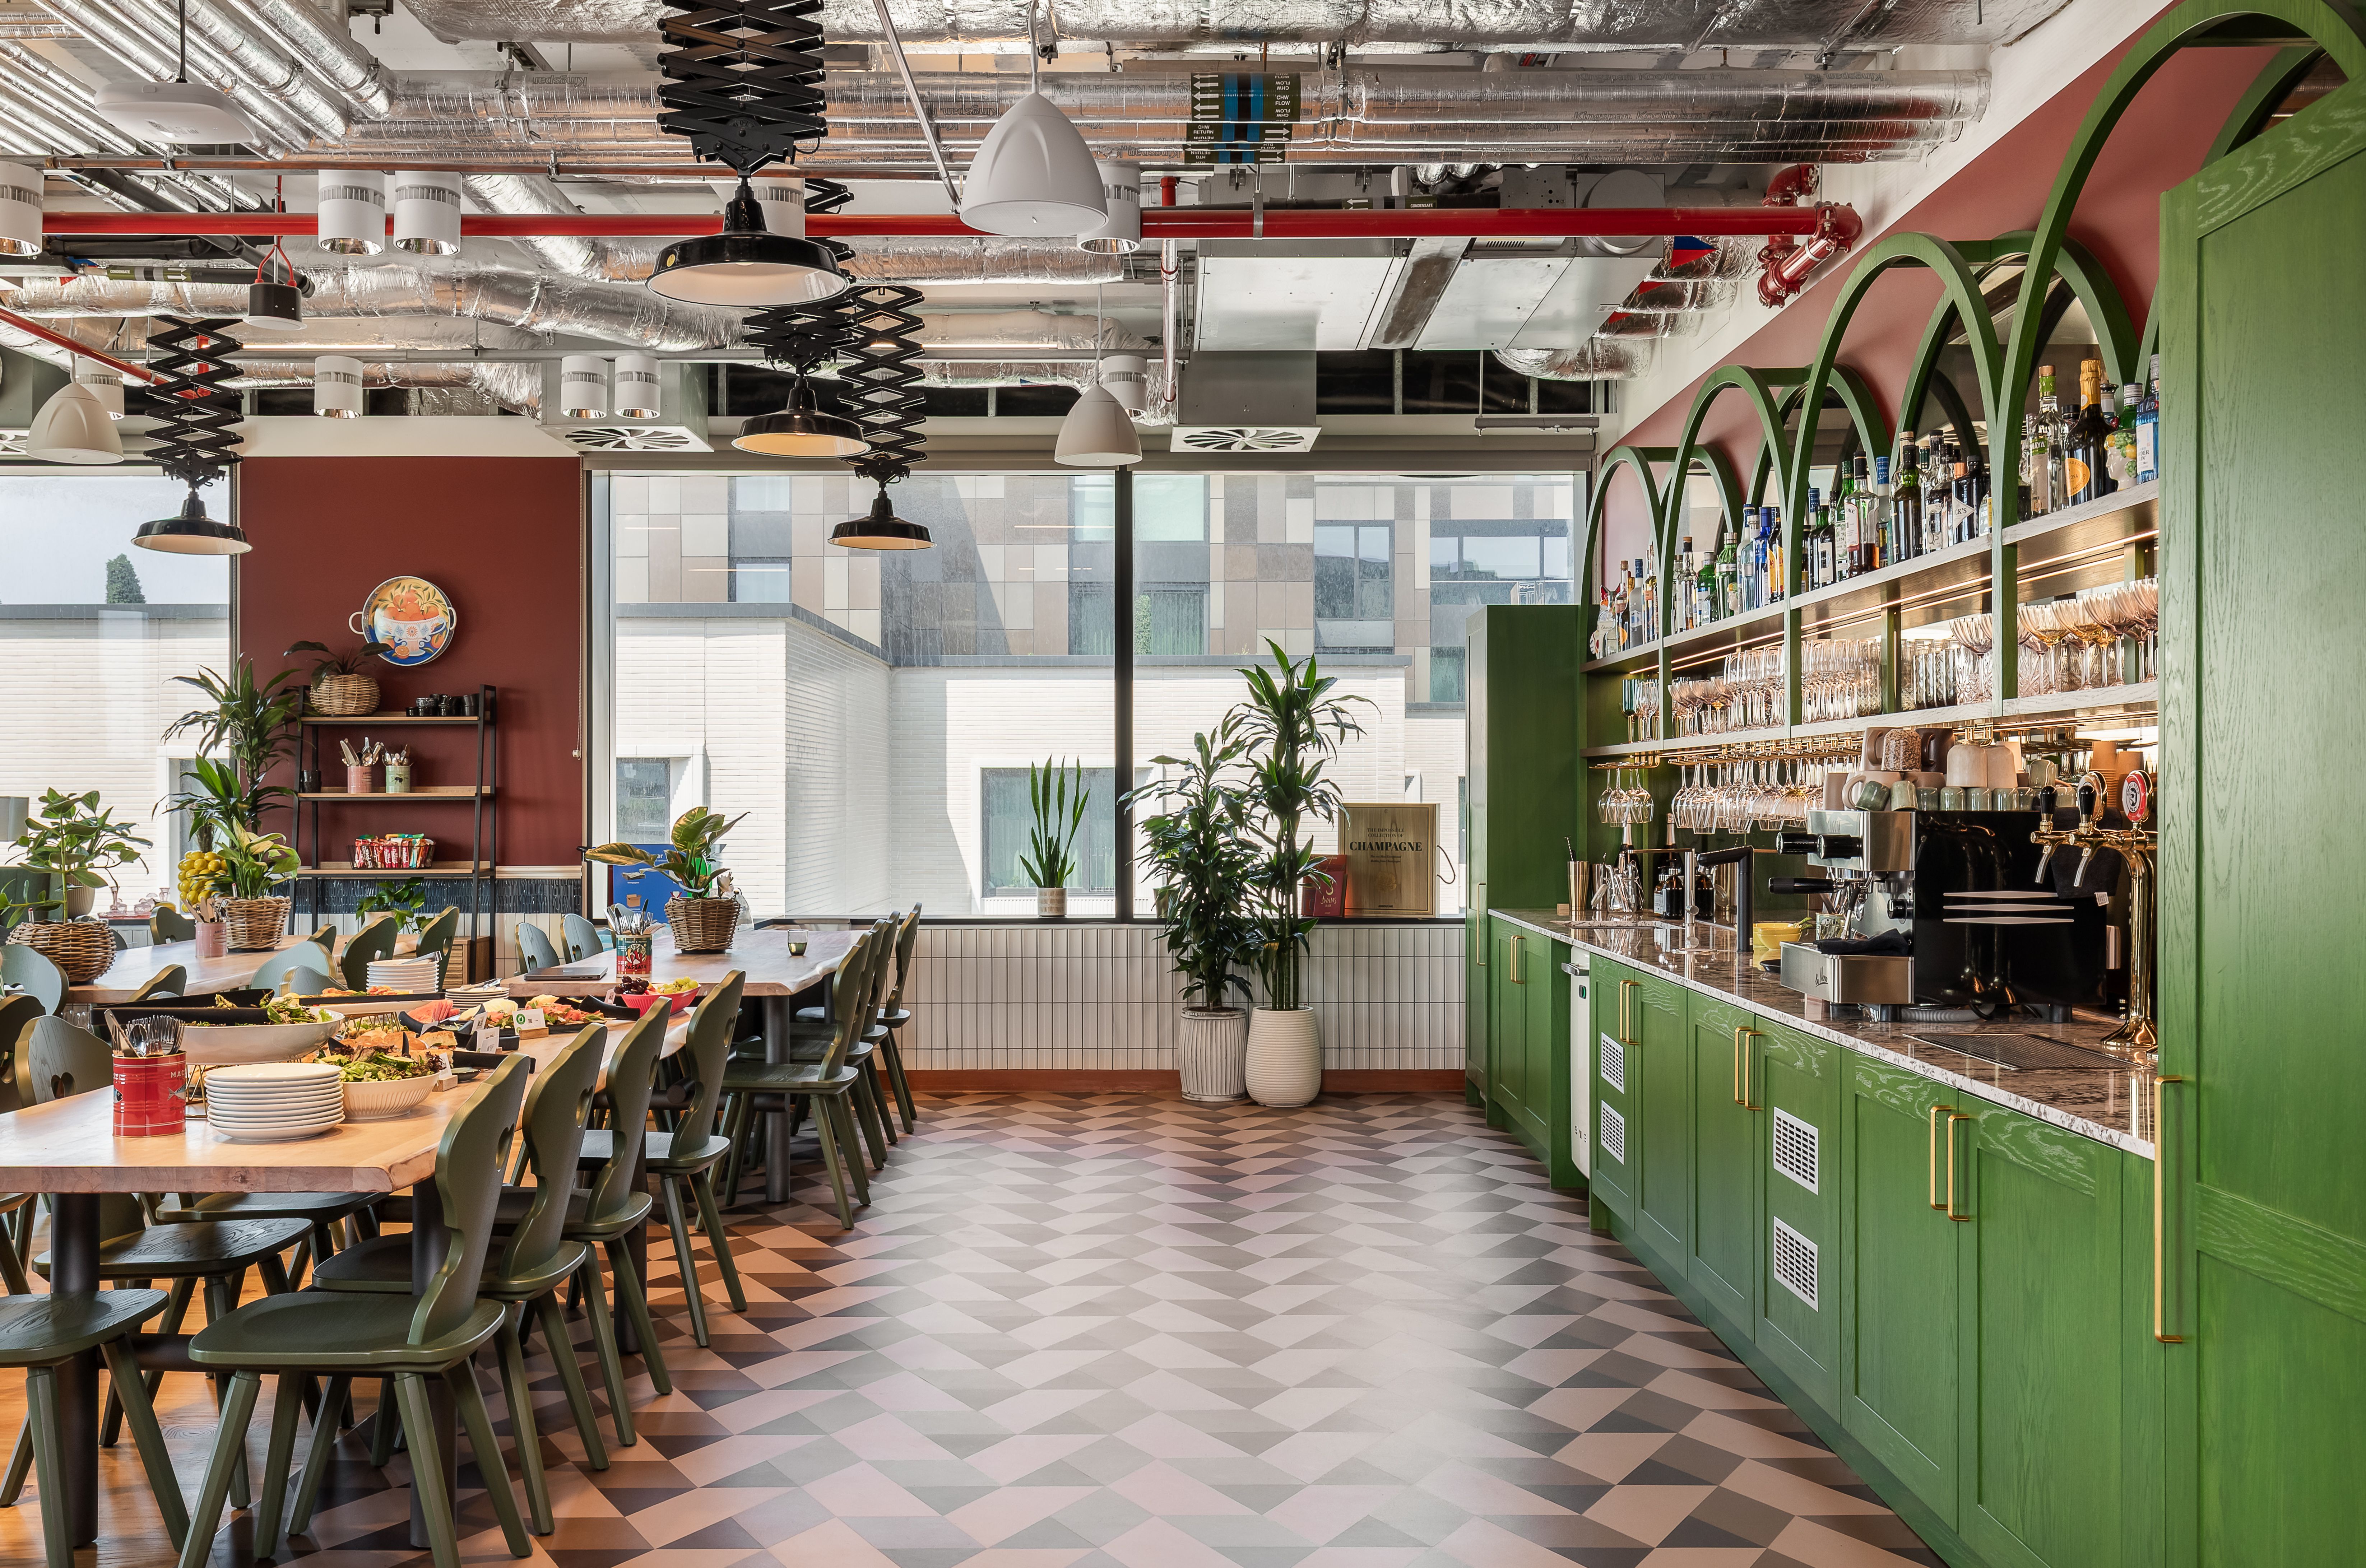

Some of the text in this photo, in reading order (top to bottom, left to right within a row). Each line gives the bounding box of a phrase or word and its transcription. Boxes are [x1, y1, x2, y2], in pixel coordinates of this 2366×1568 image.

[848, 78, 870, 88] FM
[1052, 84, 1074, 97] FM
[1349, 841, 1423, 852] CHAMPAGNE
